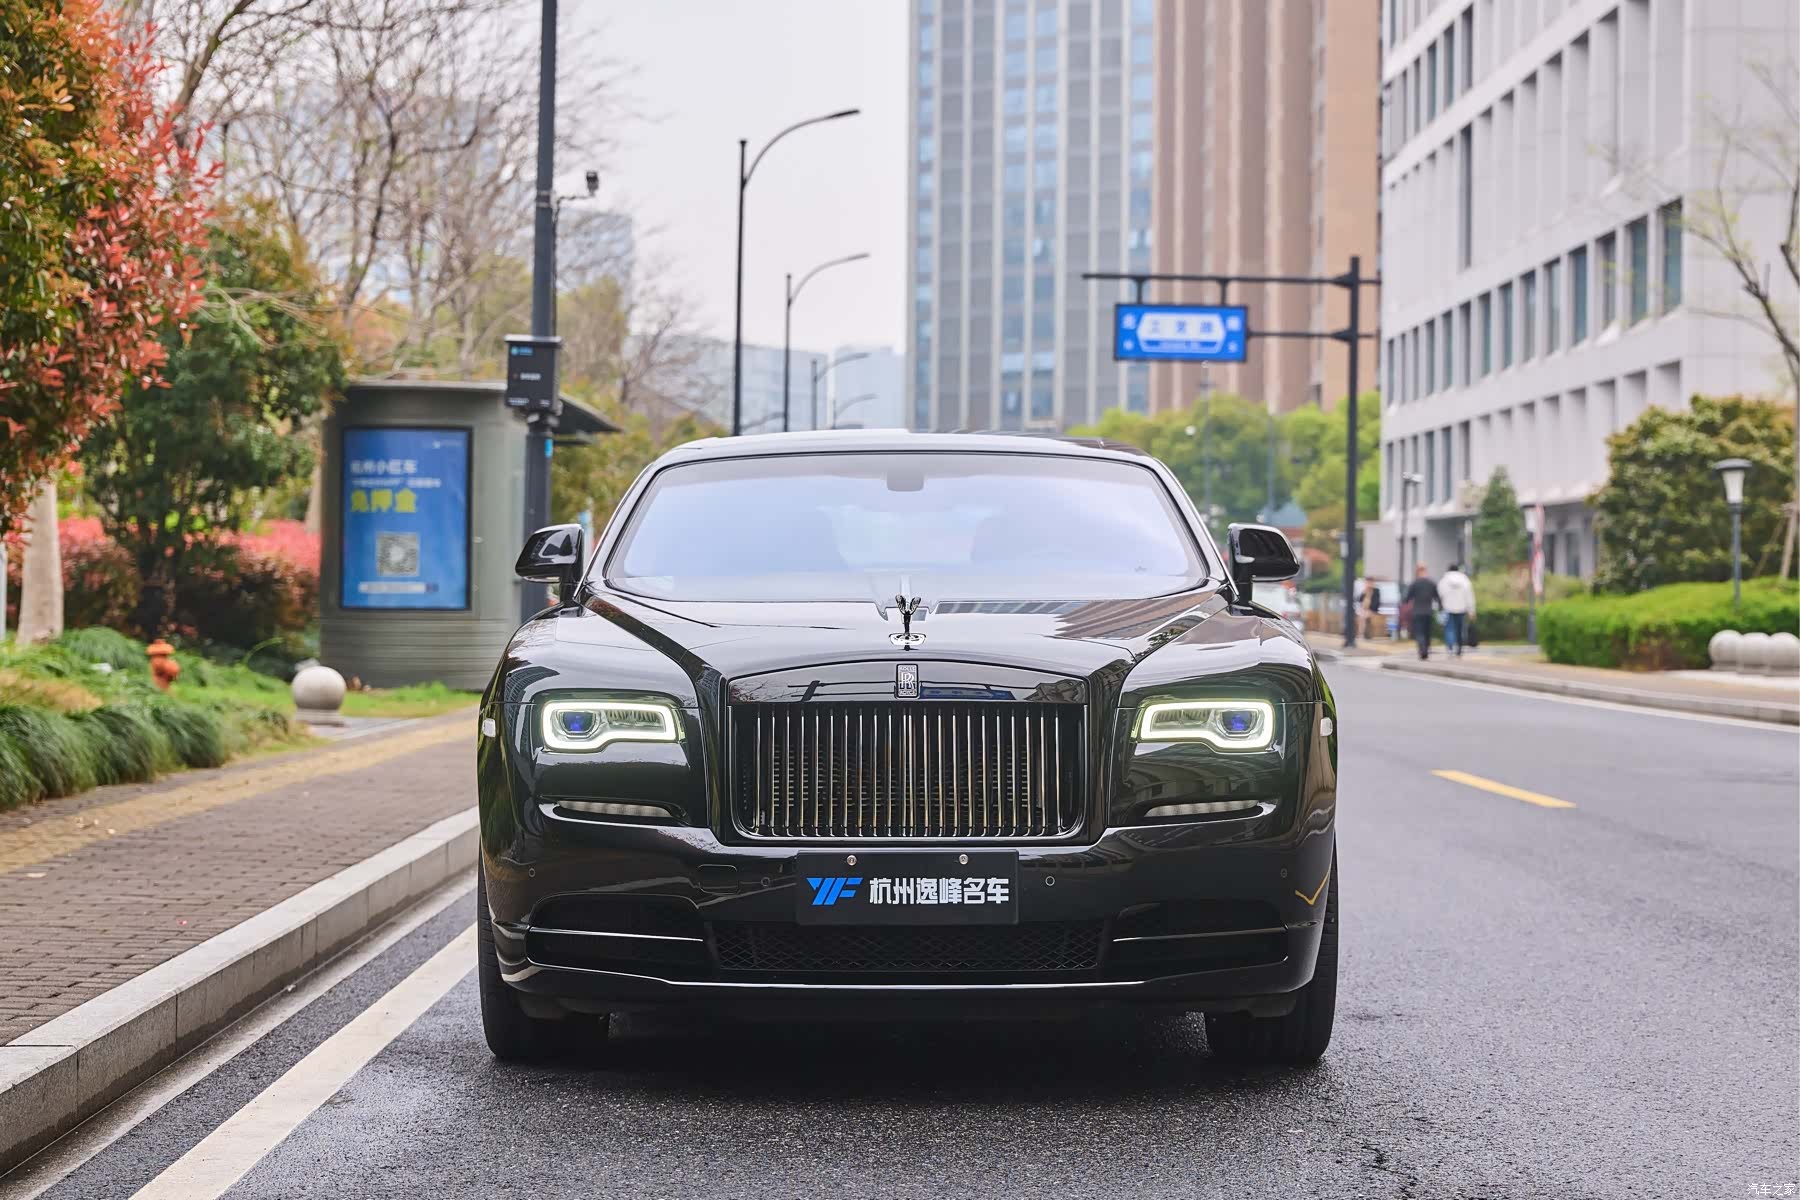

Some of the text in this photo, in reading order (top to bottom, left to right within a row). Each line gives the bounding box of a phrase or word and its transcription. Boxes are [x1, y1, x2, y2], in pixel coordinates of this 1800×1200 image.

[869, 877, 1009, 905] 杭州逸峰名车
